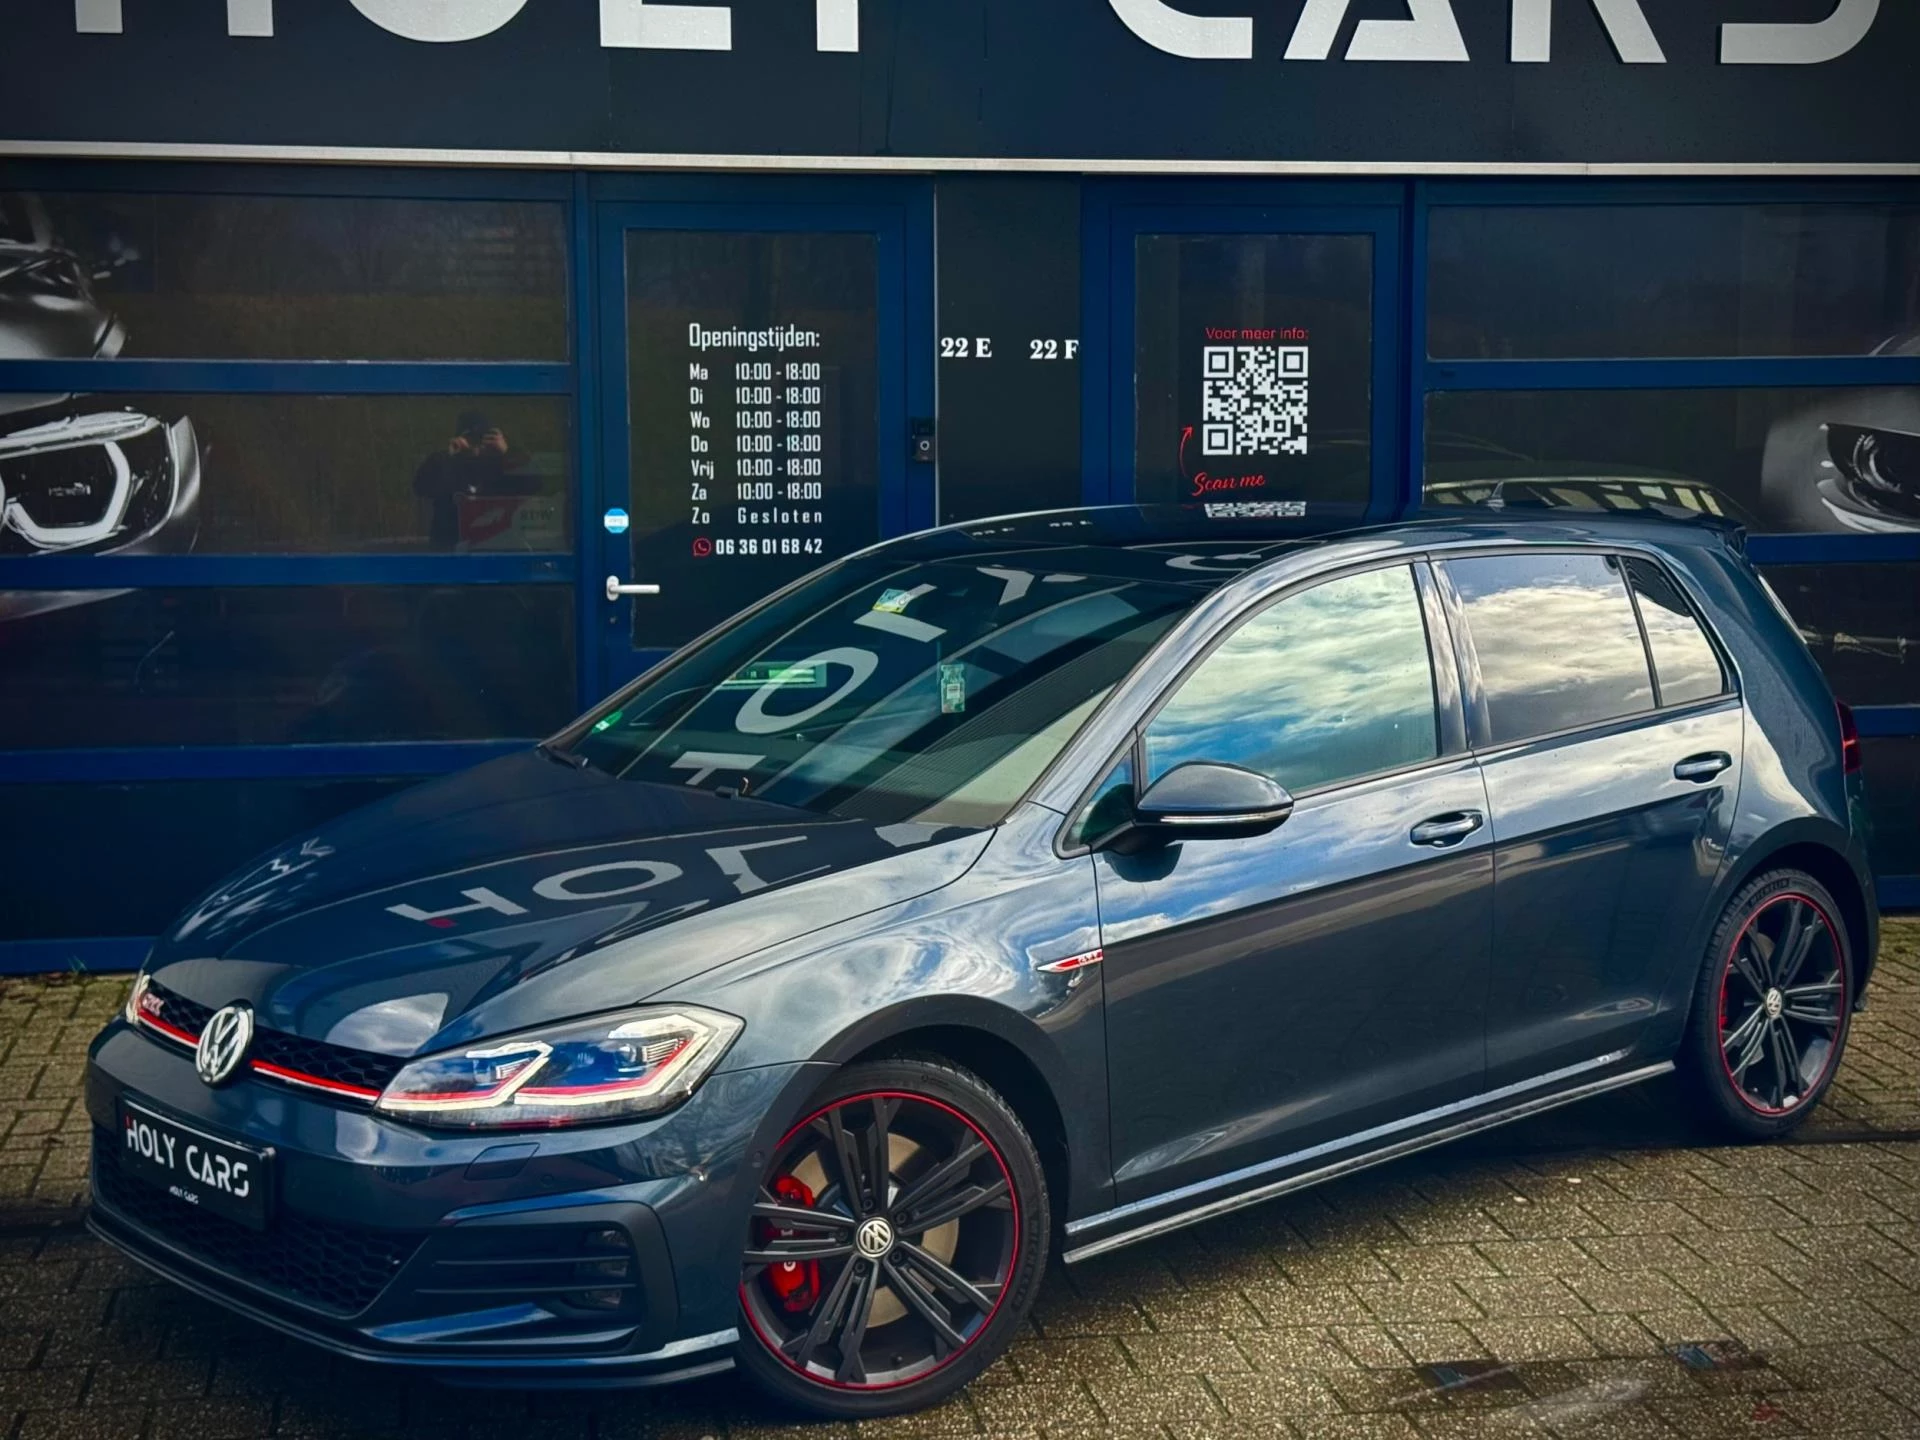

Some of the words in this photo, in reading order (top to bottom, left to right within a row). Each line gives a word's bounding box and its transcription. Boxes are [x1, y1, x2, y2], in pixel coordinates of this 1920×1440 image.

[689, 323, 820, 352] Openingstijden:
[1204, 328, 1238, 339] Voor
[1241, 328, 1276, 339] meer
[1280, 327, 1309, 339] info:
[940, 337, 969, 358] 22
[975, 337, 992, 358] E
[1029, 339, 1058, 360] 22
[1064, 339, 1080, 360] F
[689, 363, 708, 380] Ma
[735, 363, 771, 380] 10:00
[785, 363, 821, 380] 18:00
[690, 387, 703, 404] Di
[735, 387, 771, 404] 10:00
[785, 387, 821, 404] 18:00
[690, 411, 711, 428] Wo
[735, 411, 771, 428] 10:00
[785, 411, 821, 428] 18:00
[691, 435, 708, 452] Do
[736, 435, 772, 452] 10:00
[786, 435, 822, 452] 18:00
[691, 459, 715, 480] Vrij
[736, 459, 772, 476] 10:00
[786, 459, 822, 476] 18:00
[691, 483, 707, 500] Za
[736, 483, 772, 500] 10:00
[786, 483, 822, 500] 18:00
[1191, 472, 1237, 496] Scan
[1239, 475, 1265, 488] me
[692, 507, 710, 524] Zo
[737, 506, 822, 524] Gesloten
[716, 538, 734, 555] 06
[739, 538, 758, 555] 36
[762, 538, 777, 555] 01
[781, 538, 800, 555] 68
[804, 538, 823, 555] 42
[125, 1115, 176, 1169] HOLY
[185, 1145, 250, 1198] CARS
